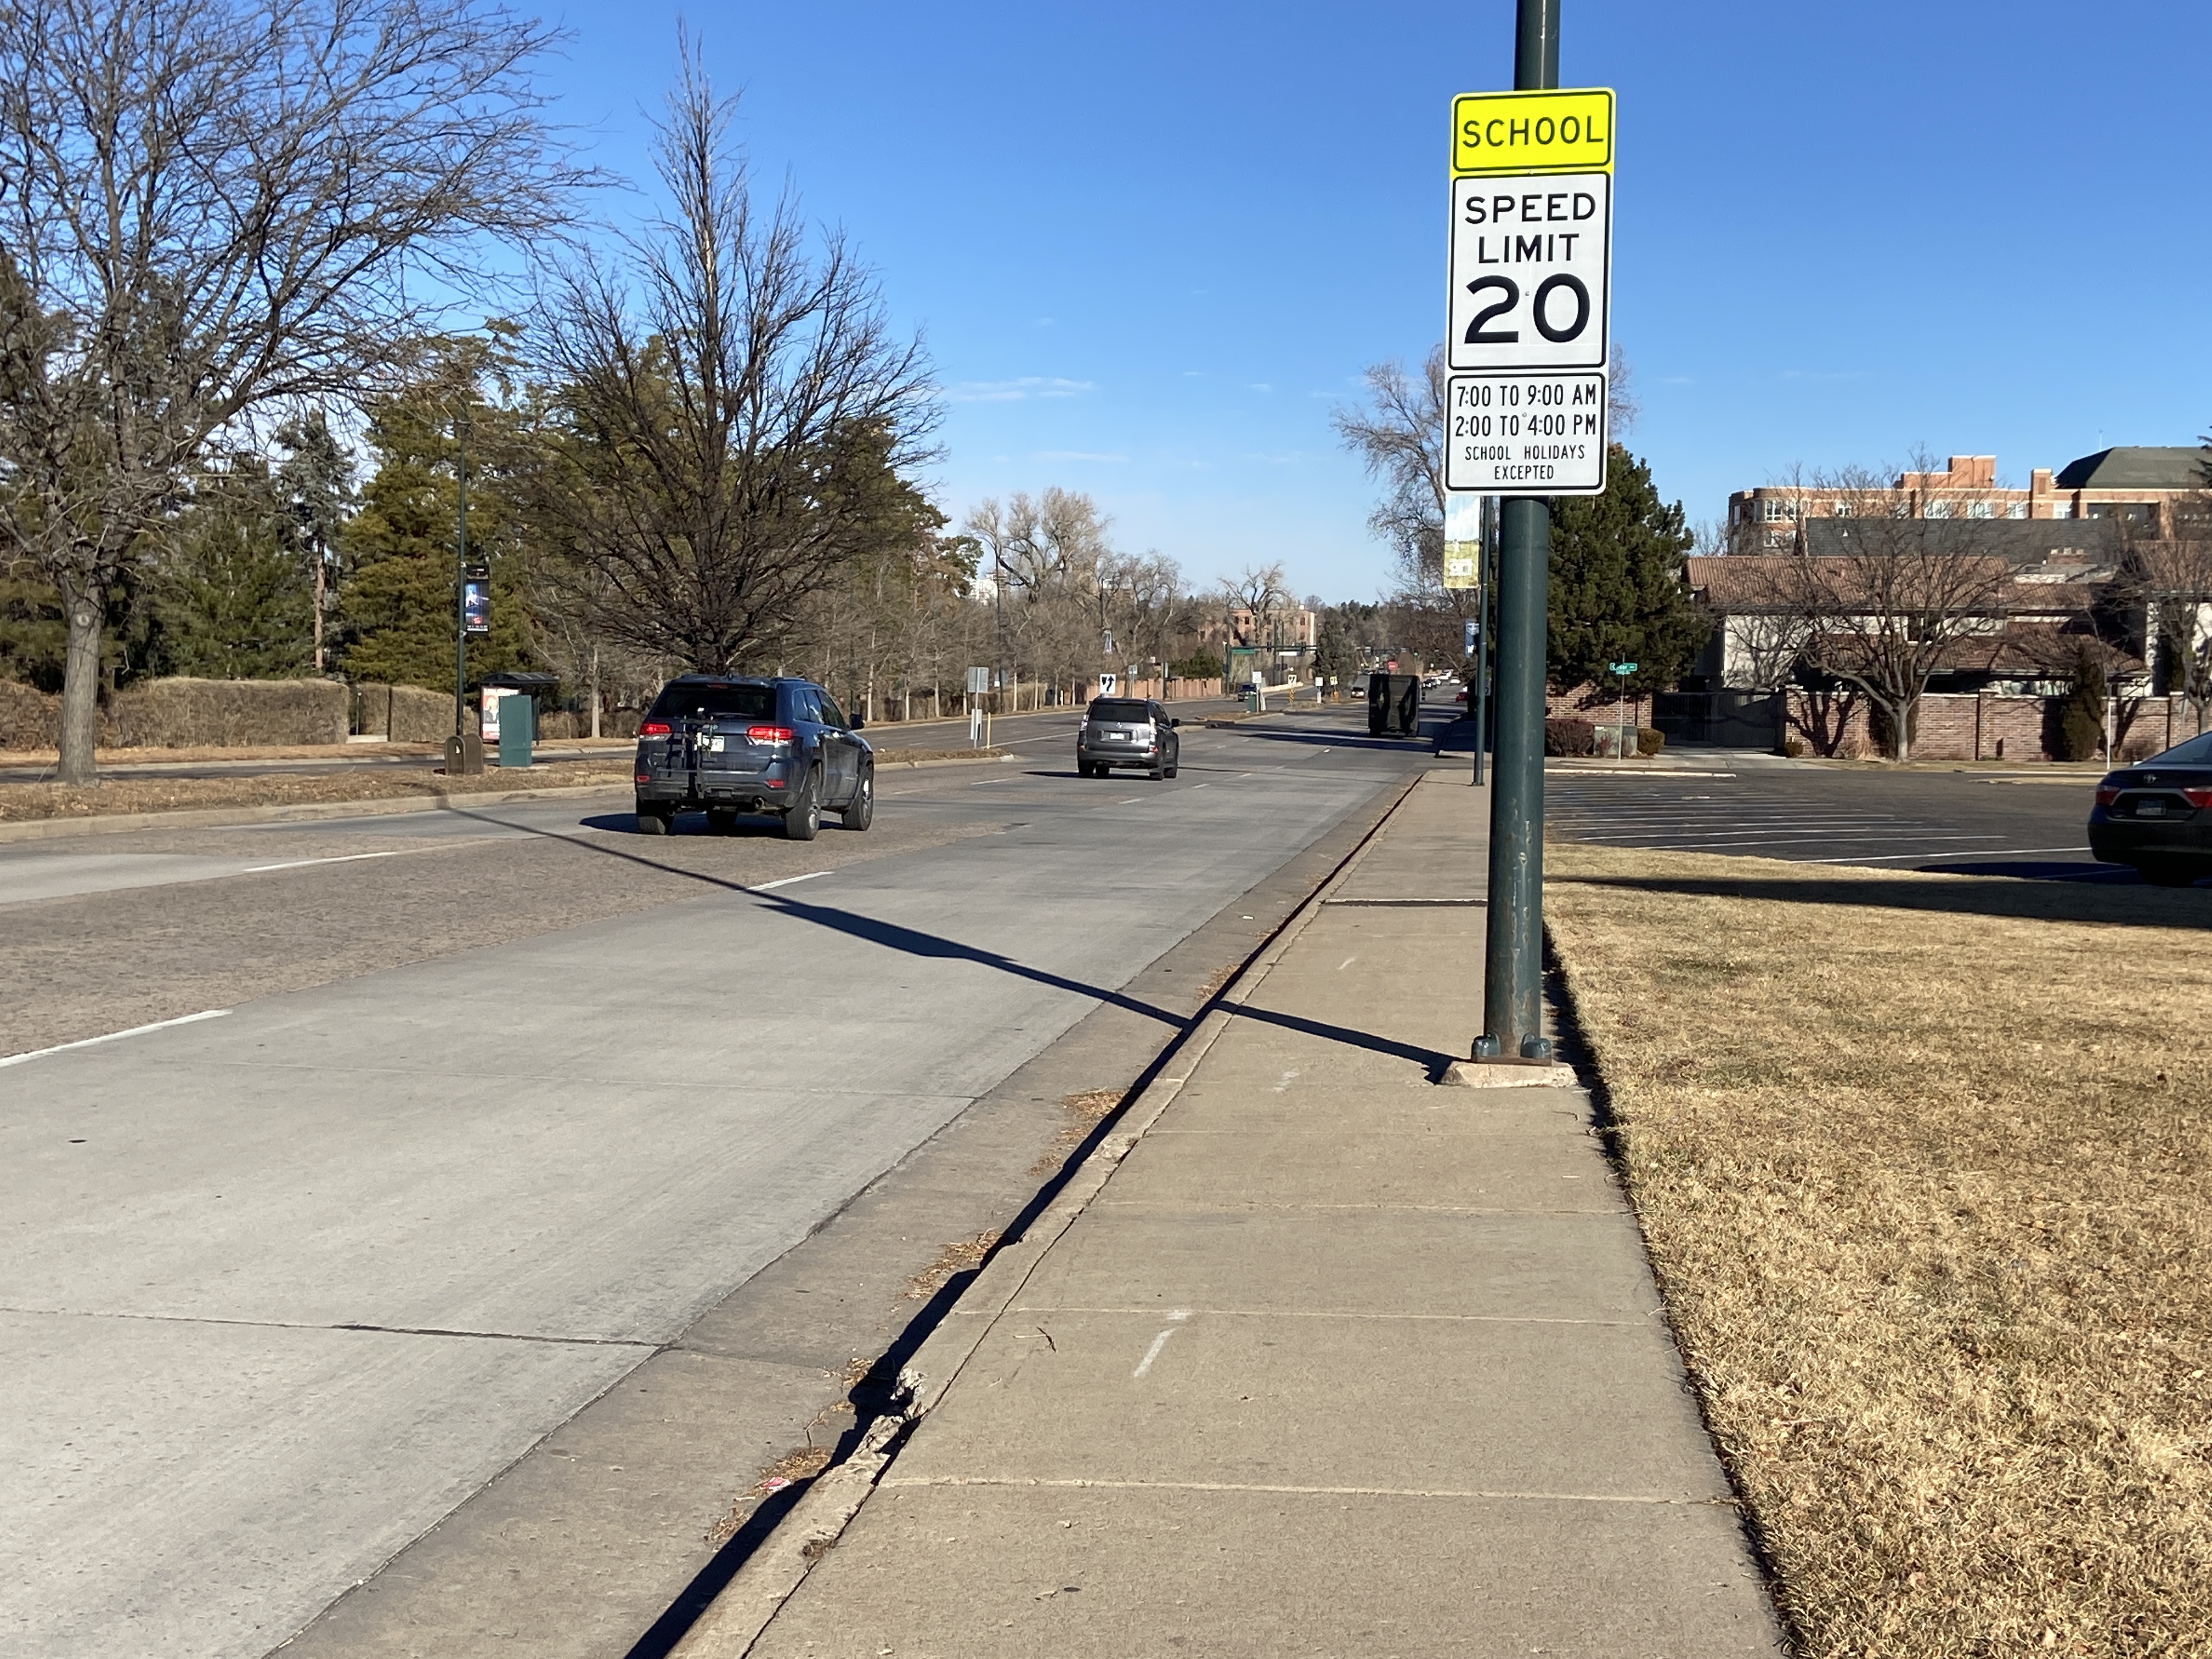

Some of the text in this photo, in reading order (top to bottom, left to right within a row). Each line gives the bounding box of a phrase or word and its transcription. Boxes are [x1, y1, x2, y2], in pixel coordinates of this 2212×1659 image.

[1463, 116, 1604, 148] SCHOOL
[1465, 193, 1595, 224] SPEED
[1479, 234, 1579, 263] LIMIT
[1464, 274, 1590, 344] 20
[1458, 384, 1596, 407] 7:00 TO 9:00 AM
[1455, 414, 1596, 437] 2:00 TO 4:00 PM
[1465, 445, 1585, 460] SCHOOL HOLIDAYS
[1494, 465, 1554, 479] EXCEPTED
